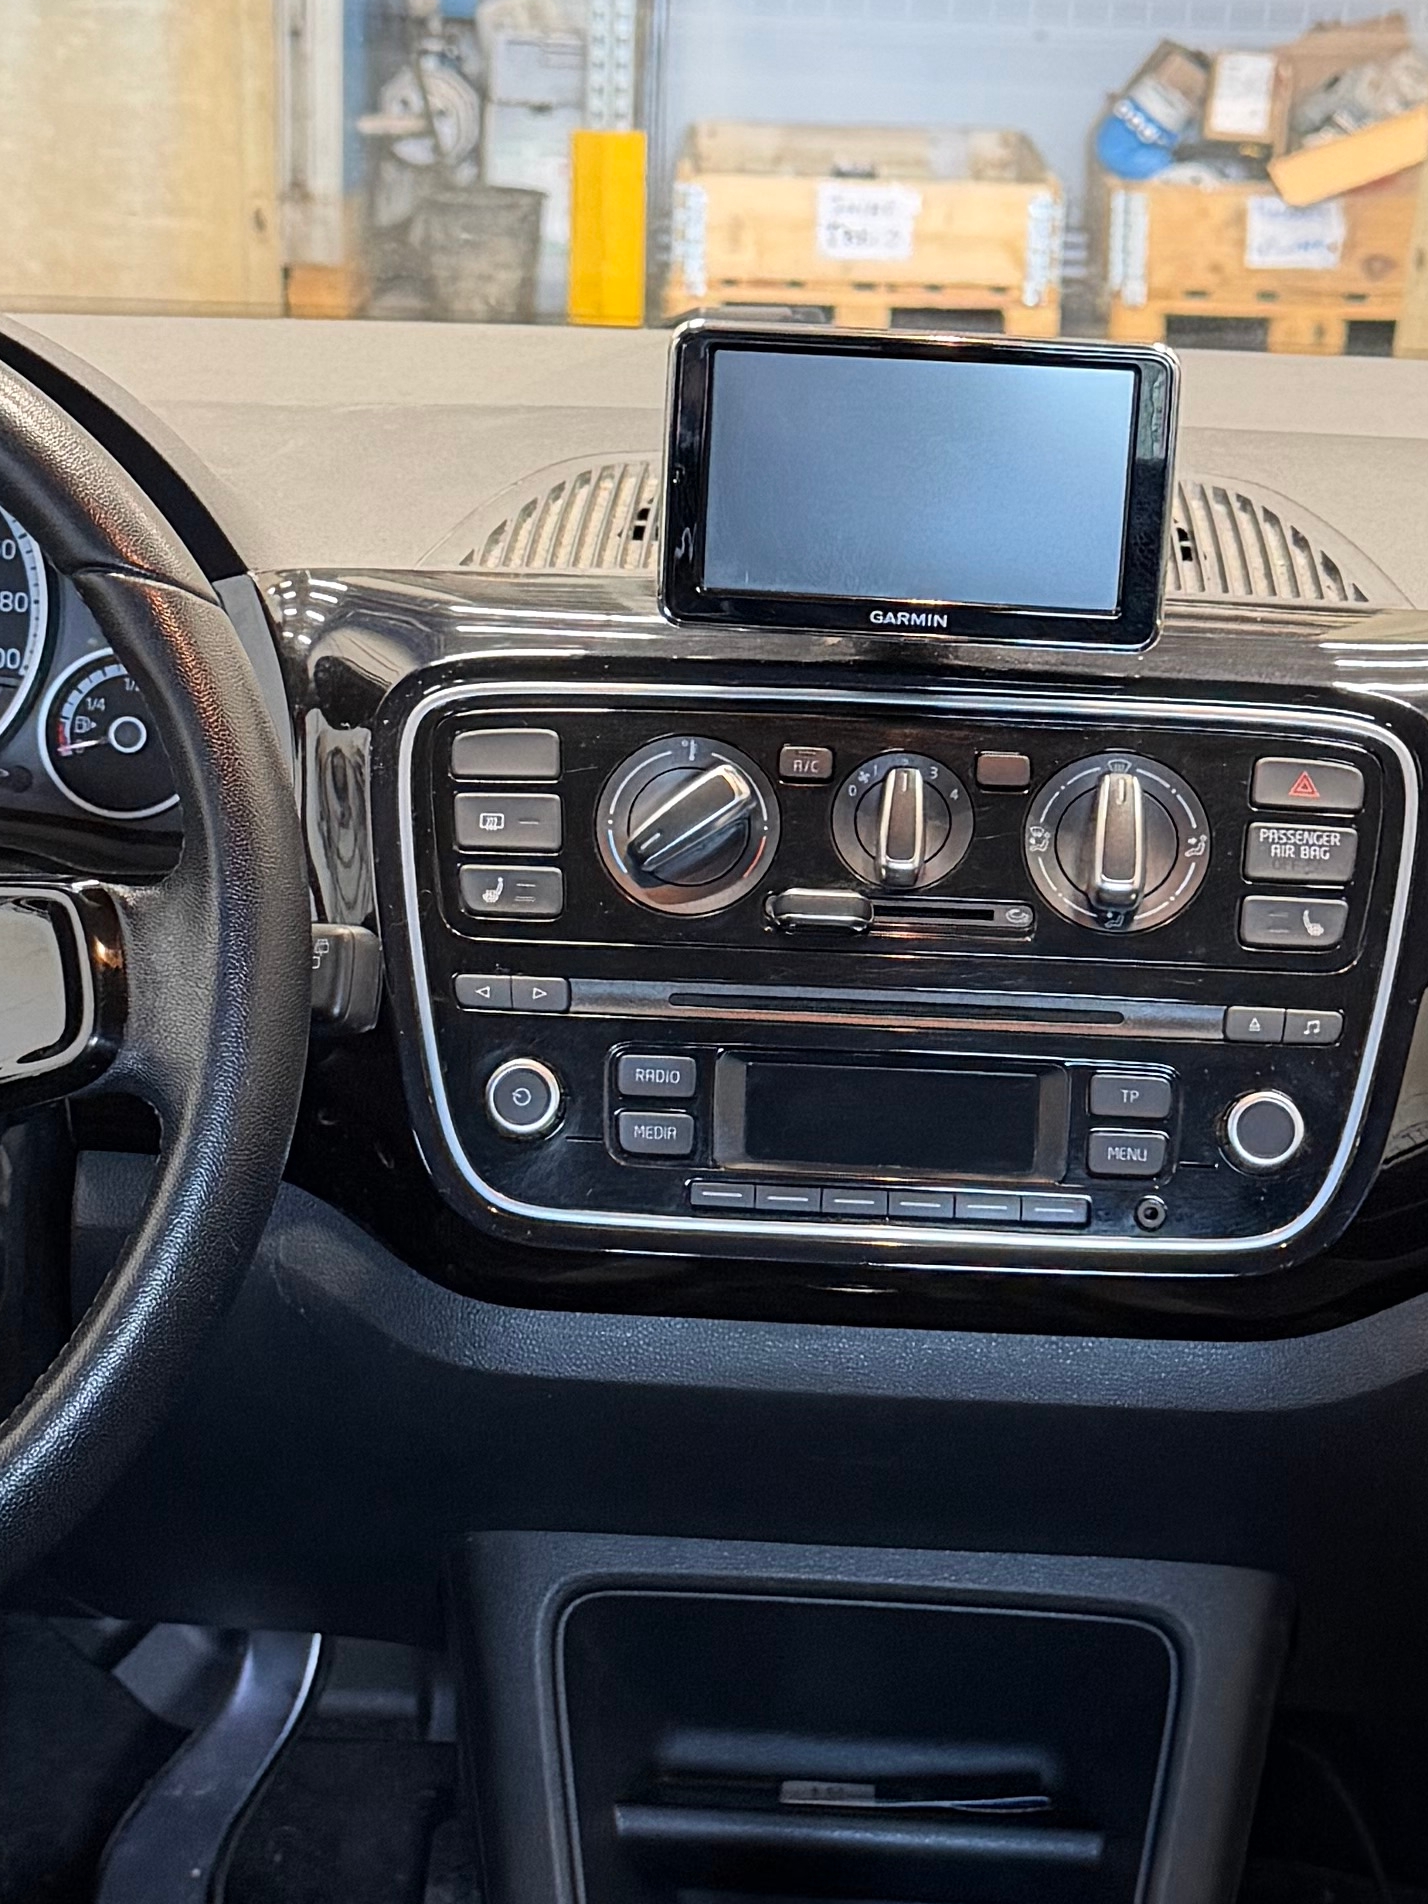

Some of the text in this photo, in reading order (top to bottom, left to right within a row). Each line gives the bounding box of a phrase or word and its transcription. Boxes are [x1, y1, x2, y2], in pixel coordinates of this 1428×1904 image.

[869, 610, 949, 628] GARMIN
[86, 697, 106, 711] 1/4
[793, 759, 819, 774] A/C
[930, 766, 939, 780] 3
[847, 784, 858, 797] 0
[949, 788, 960, 801] 4
[1259, 828, 1341, 846] PASSENGER
[1270, 844, 1330, 860] AIR BAG
[635, 1068, 681, 1084] RADIO
[1120, 1089, 1140, 1103] TP
[633, 1125, 677, 1140] MEDIA
[1107, 1146, 1148, 1162] MENU
